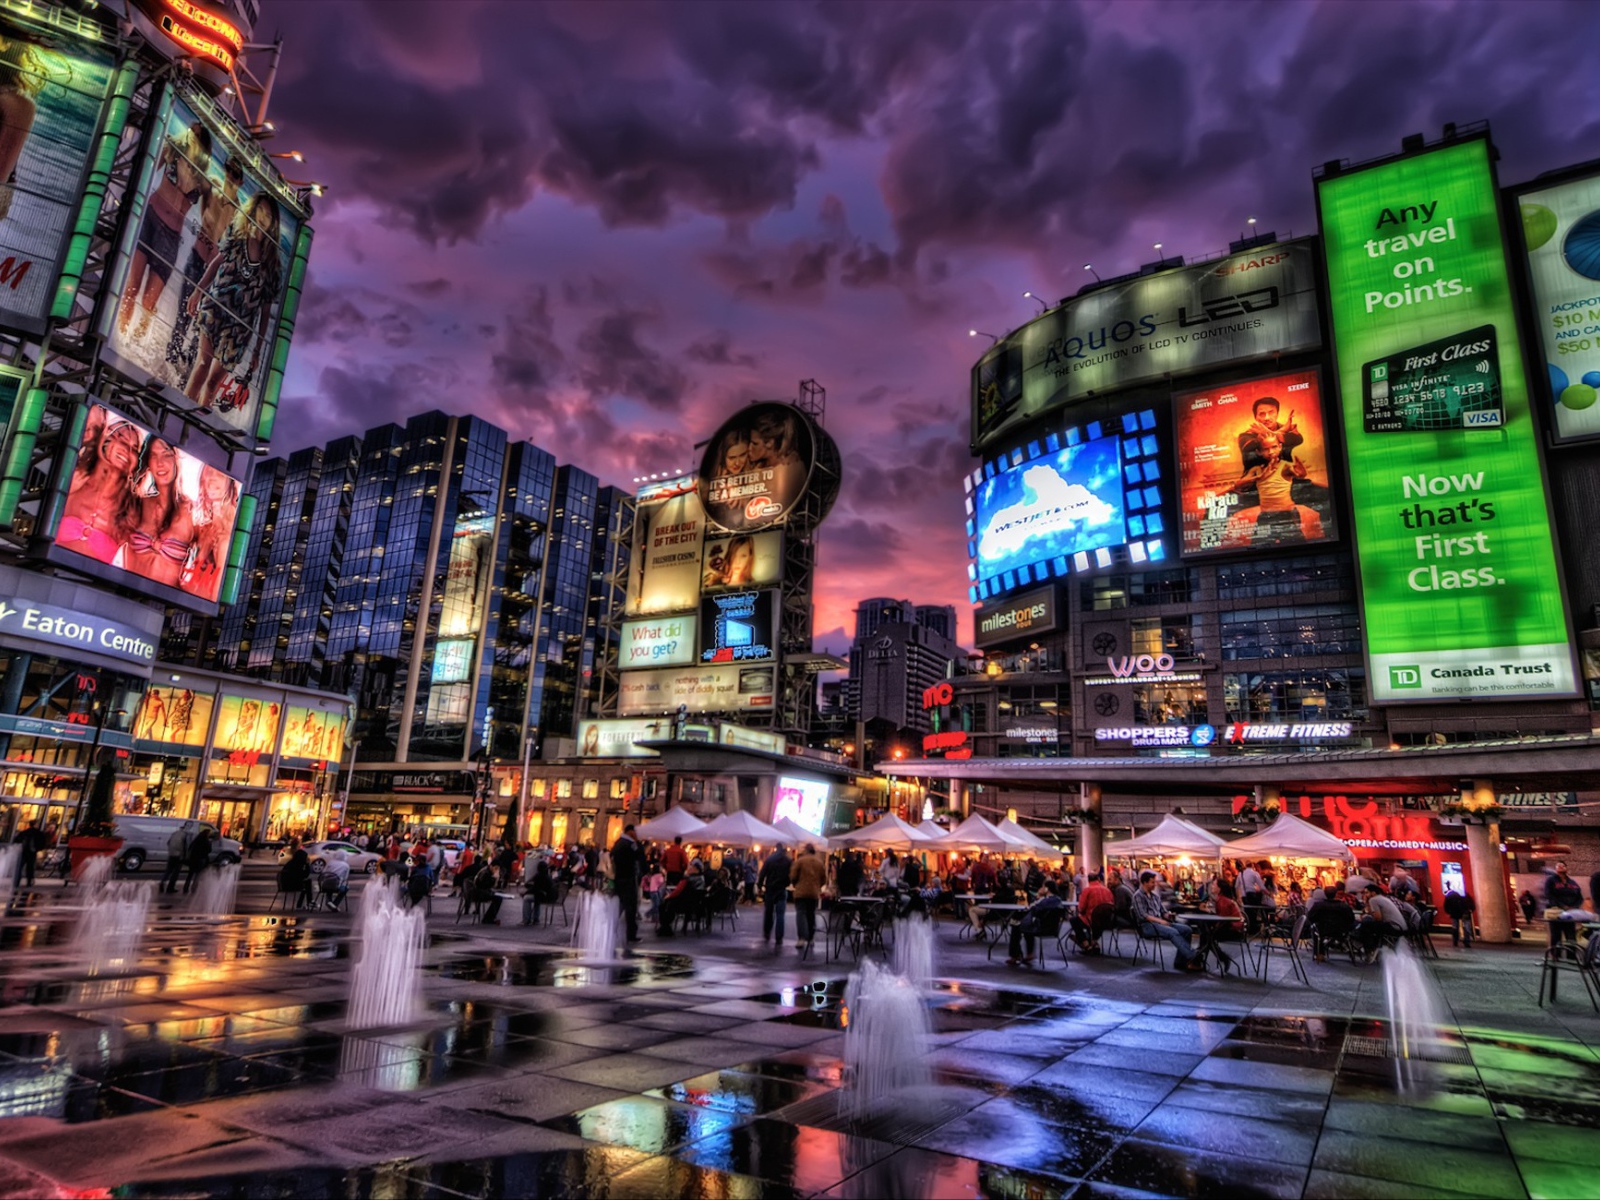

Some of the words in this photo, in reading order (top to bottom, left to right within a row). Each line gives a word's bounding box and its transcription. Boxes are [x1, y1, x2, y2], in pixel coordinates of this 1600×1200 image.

[1376, 200, 1438, 229] Any
[1364, 218, 1456, 258] travel
[1215, 252, 1290, 278] SHARP
[1393, 256, 1434, 278] on
[1364, 278, 1472, 313] Points.
[1044, 314, 1157, 370] AQUOS
[1179, 286, 1280, 328] LED
[1553, 312, 1583, 328] $10
[1555, 329, 1580, 340] AND
[1054, 365, 1070, 379] THE
[1073, 348, 1128, 372] EVOLUTION
[1131, 343, 1146, 355] OF
[1149, 338, 1171, 350] LCD
[1174, 334, 1189, 345] TV
[1192, 319, 1265, 341] CONTINUES.
[1403, 352, 1438, 371] First
[1441, 339, 1491, 361] Class
[1558, 339, 1591, 355] $50
[1373, 366, 1386, 378] TD
[1392, 383, 1408, 391] VISA
[1393, 394, 1415, 405] 1234
[1453, 382, 1485, 396] 9123
[1467, 412, 1498, 424] VISA
[727, 472, 760, 487] BETTER
[762, 469, 774, 480] TO
[1402, 471, 1485, 499] Now
[709, 490, 720, 502] BE
[721, 488, 729, 499] A
[1197, 492, 1239, 509] Karate
[1208, 505, 1228, 520] Kid
[1399, 498, 1496, 529] that's
[655, 525, 679, 537] BREAK
[681, 520, 697, 531] OUT
[654, 537, 663, 547] OF
[665, 535, 679, 545] THE
[680, 532, 698, 543] CITY
[1415, 531, 1491, 559] First
[1407, 565, 1506, 592] Class.
[982, 603, 1046, 633] milestones
[22, 608, 94, 642] Eaton
[100, 628, 154, 659] Centre
[632, 626, 662, 641] What
[665, 622, 682, 638] did
[630, 644, 650, 661] you
[652, 640, 678, 659] get?
[1107, 653, 1175, 678] WOO
[1392, 669, 1418, 685] TD
[1431, 665, 1495, 679] Canada
[1500, 662, 1553, 675] Trust
[632, 684, 645, 692] cash
[646, 682, 660, 692] back
[675, 676, 699, 685] nothing
[701, 675, 715, 683] with
[1432, 684, 1463, 695] Banking
[1479, 682, 1490, 691] be
[1491, 682, 1505, 691] this
[1505, 680, 1555, 690] comfortable
[687, 685, 695, 694] of
[696, 684, 715, 695] diddly
[1006, 727, 1058, 738] milestones
[1095, 726, 1190, 740] SHOPPERS
[1132, 737, 1160, 746] DRUG
[1161, 737, 1189, 745] MART
[1224, 721, 1289, 744] EXTREME
[1290, 723, 1352, 738] FITNESS
[1349, 839, 1379, 848] OPERA
[1383, 840, 1425, 849] COMEDY
[1429, 841, 1463, 850] MUSIC
